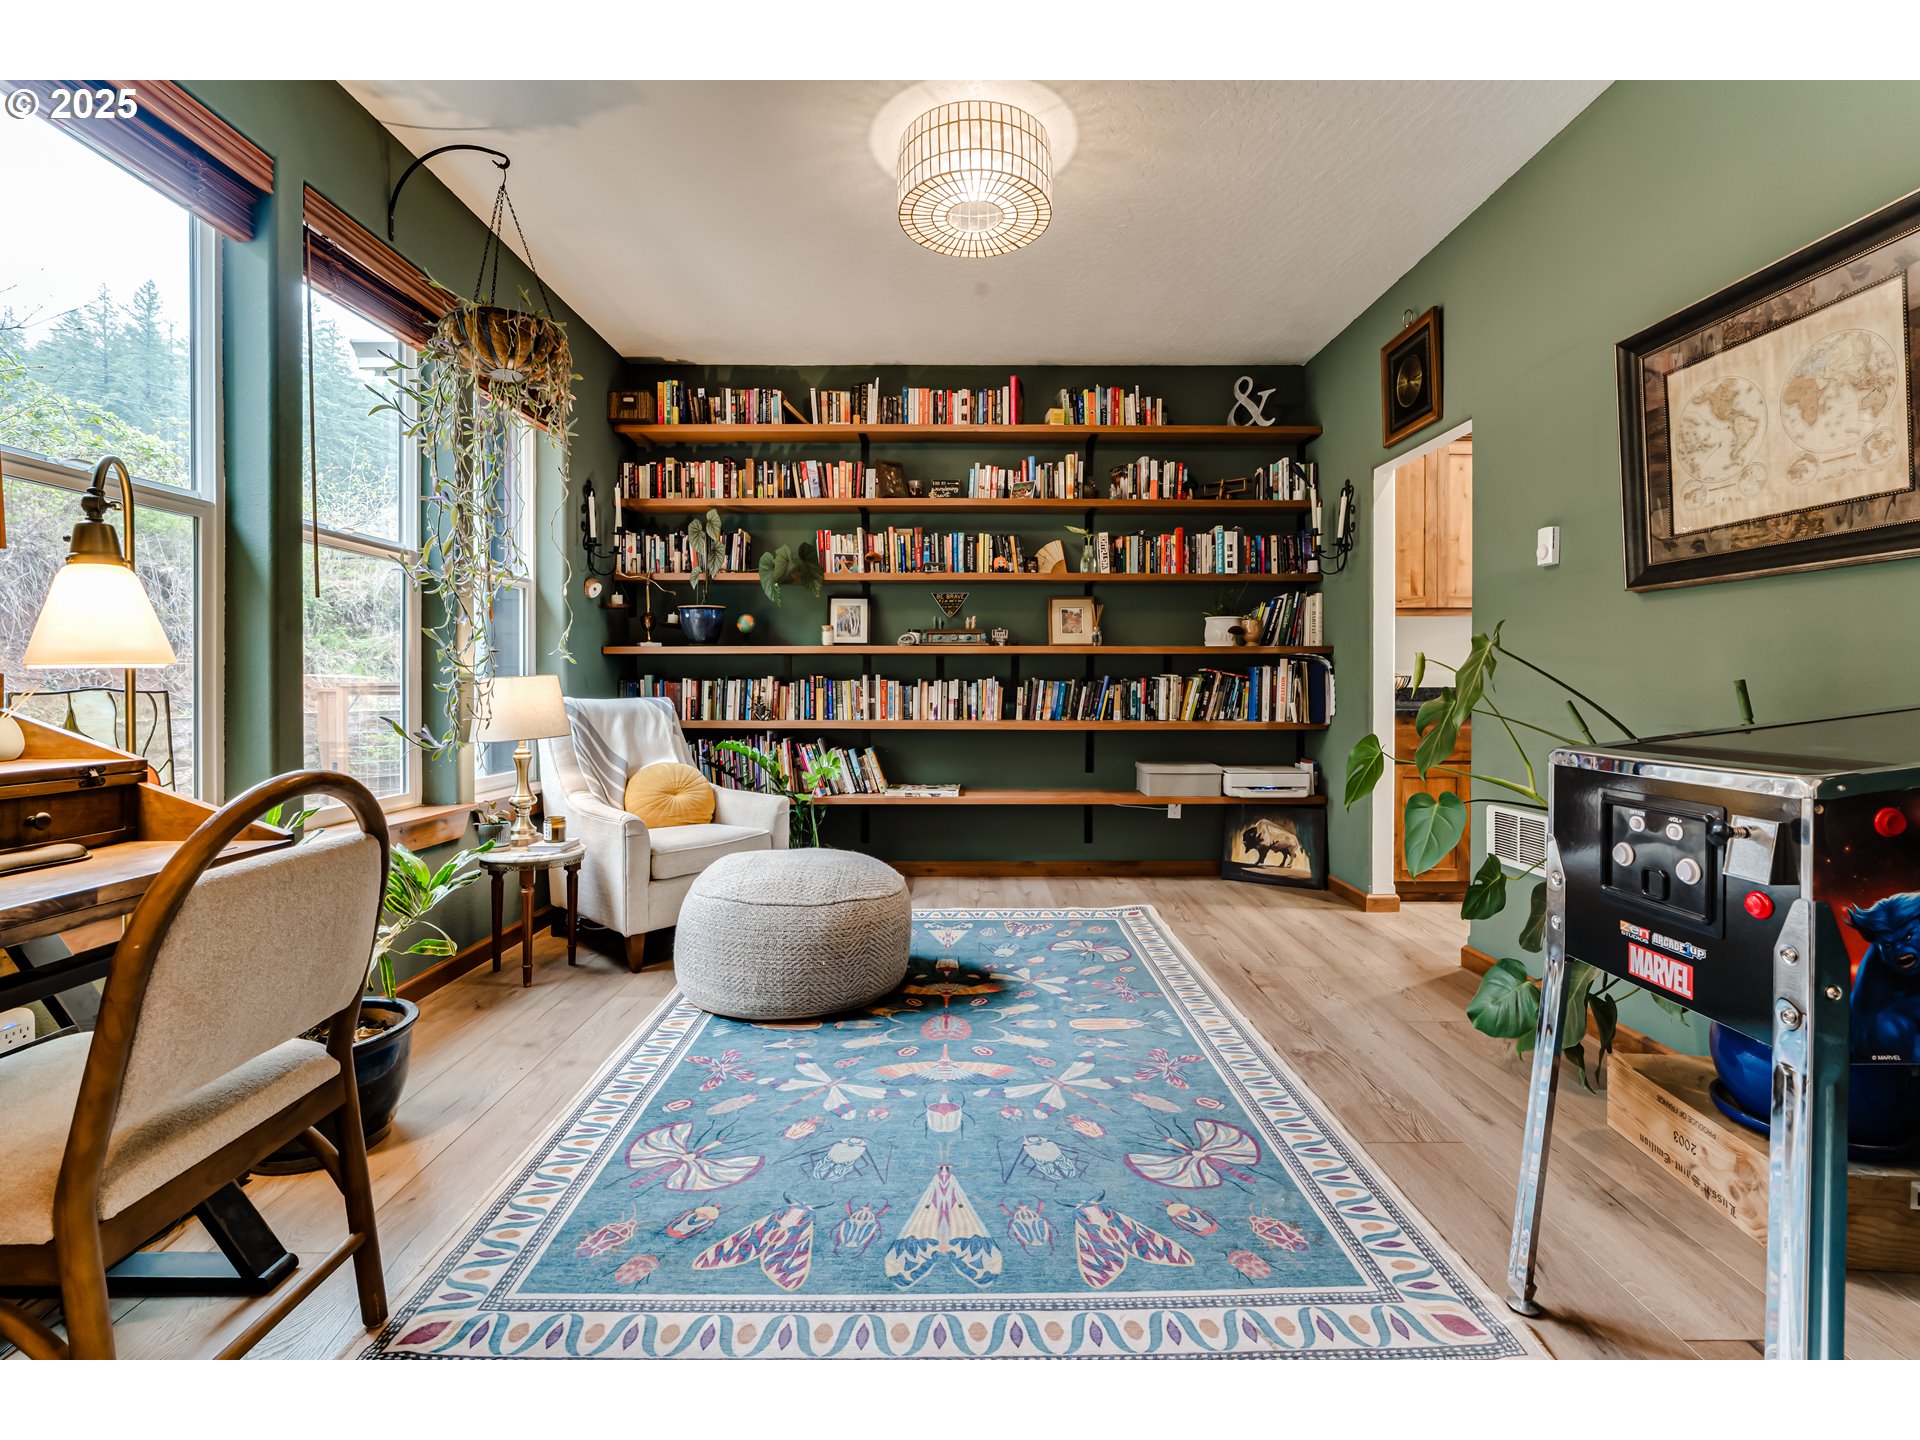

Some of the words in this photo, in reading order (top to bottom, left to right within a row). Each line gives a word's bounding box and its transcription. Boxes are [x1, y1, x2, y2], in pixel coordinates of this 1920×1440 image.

[1629, 809, 1646, 817] OFF/ON
[1620, 920, 1650, 940] zen
[1620, 930, 1650, 944] STUDIOS
[1629, 944, 1692, 997] MARVEL
[1656, 1094, 1679, 1114] FRANCE
[1679, 1110, 1688, 1120] OF
[1687, 1115, 1717, 1140] PRODUCE
[1673, 1130, 1697, 1155] 2003
